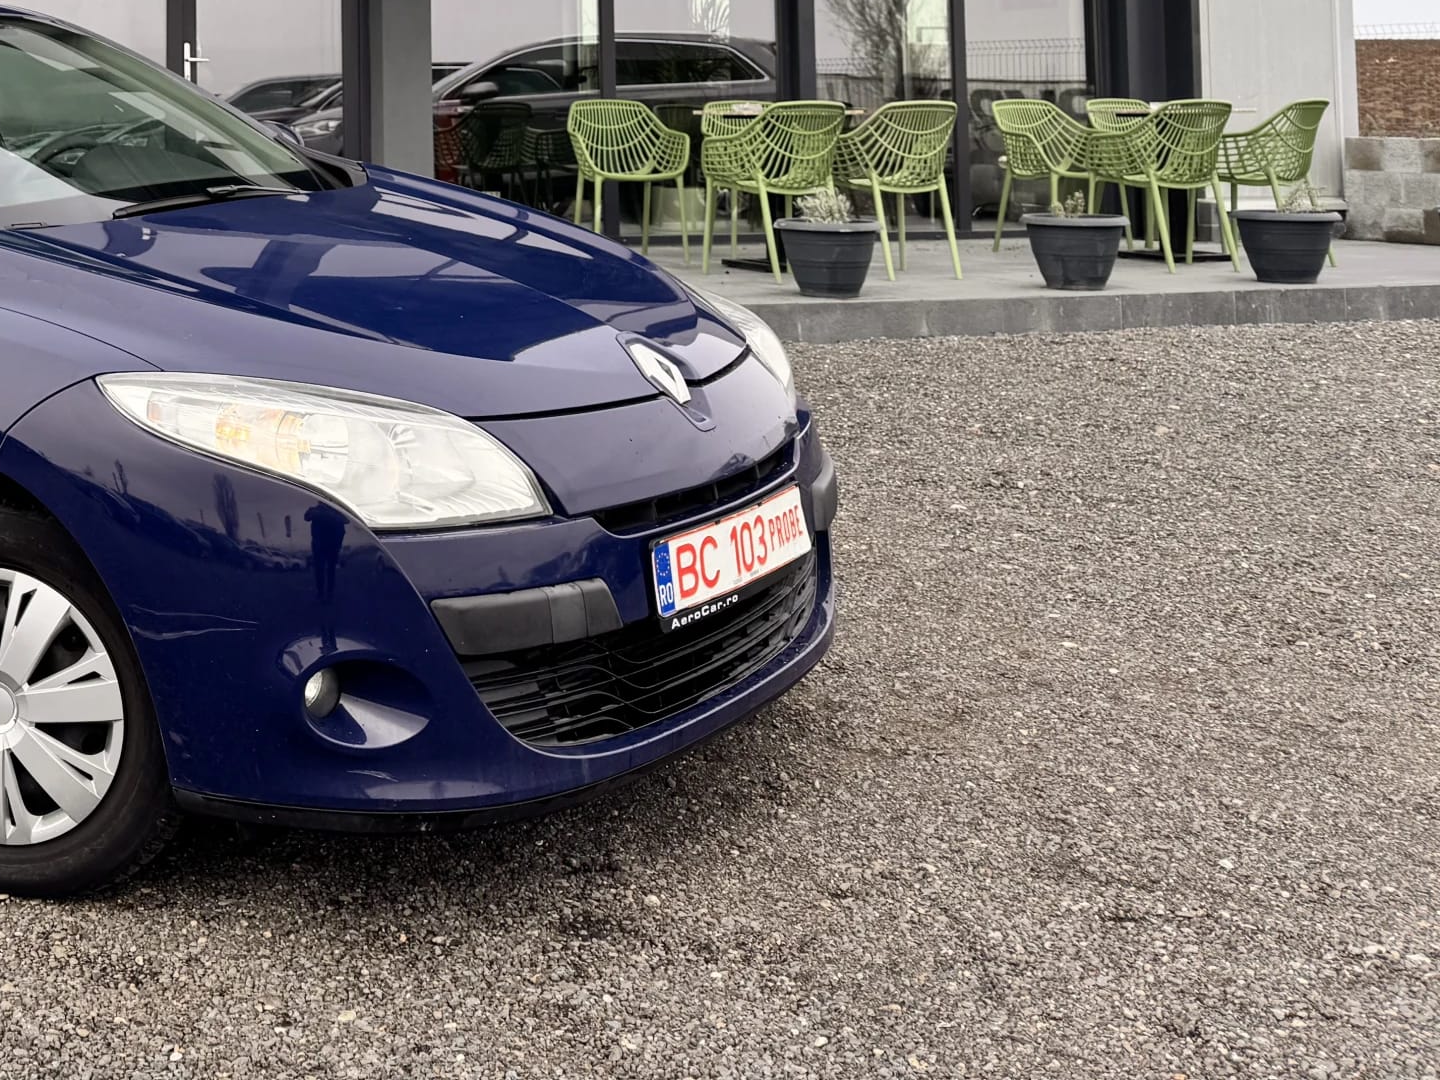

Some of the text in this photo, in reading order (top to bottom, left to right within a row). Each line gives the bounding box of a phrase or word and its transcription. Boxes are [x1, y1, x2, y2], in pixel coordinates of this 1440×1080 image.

[676, 505, 803, 599] BC 103 PROBE
[660, 582, 674, 607] RO
[671, 594, 739, 630] AeroCar.ro
